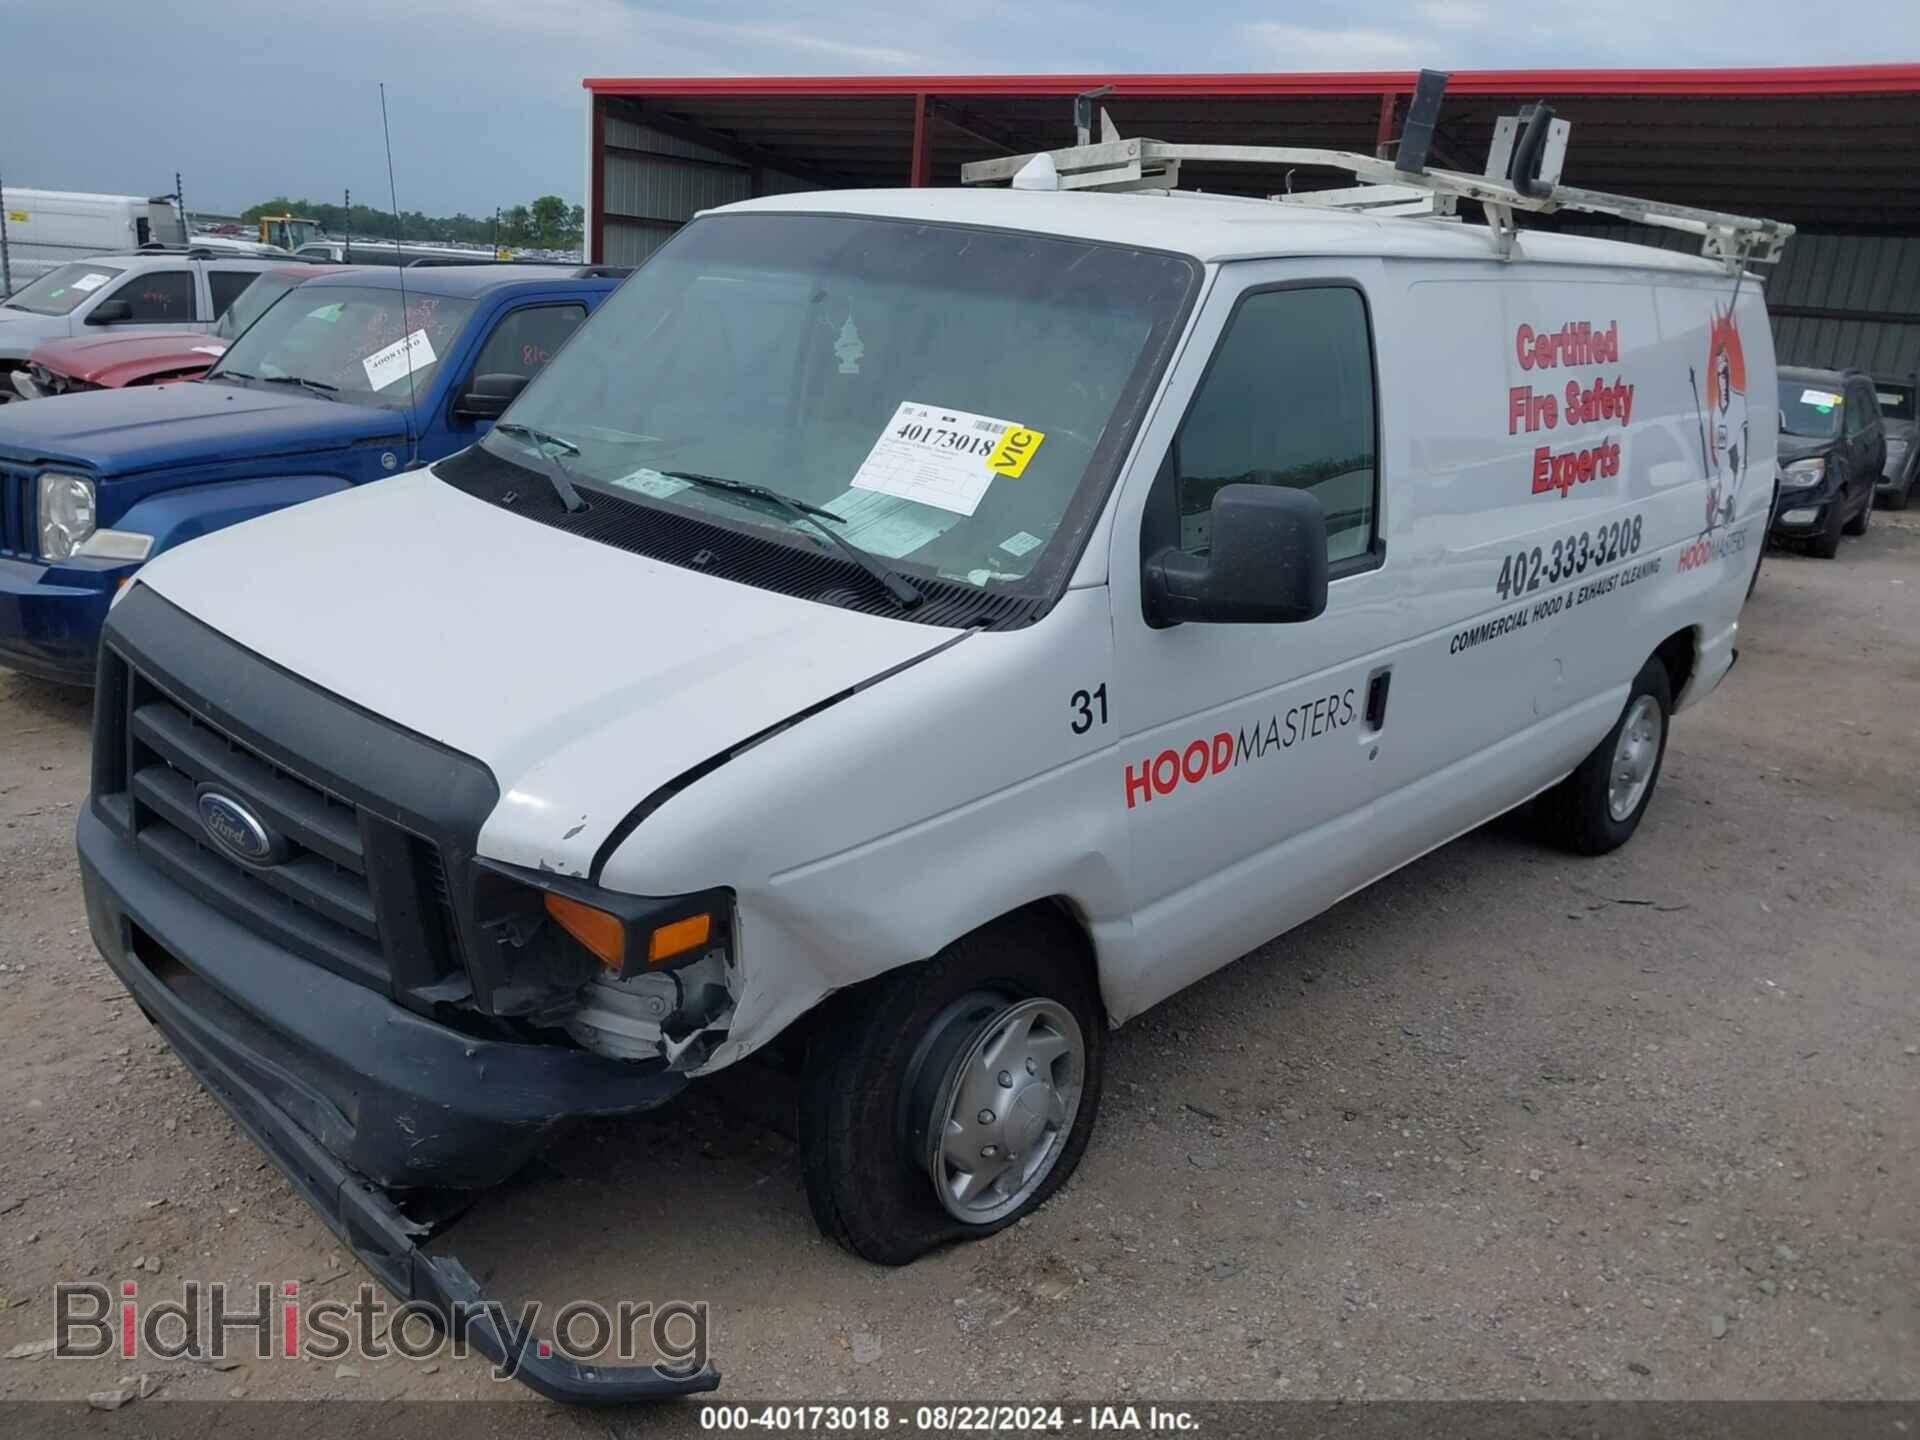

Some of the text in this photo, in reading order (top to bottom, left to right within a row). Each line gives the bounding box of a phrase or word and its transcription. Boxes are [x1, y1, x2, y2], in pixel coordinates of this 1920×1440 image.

[1516, 320, 1618, 371] Certified
[1509, 374, 1633, 435] Fire Safety
[897, 422, 997, 457] 40173018
[994, 430, 1033, 469] VIC
[1531, 436, 1620, 498] Experts
[1496, 514, 1643, 600] 402-333-3208
[1450, 558, 1661, 656] COMMERCIAL HOOD & EXHAUST CLEANING
[1070, 682, 1108, 735] 31
[208, 805, 247, 848] Ford
